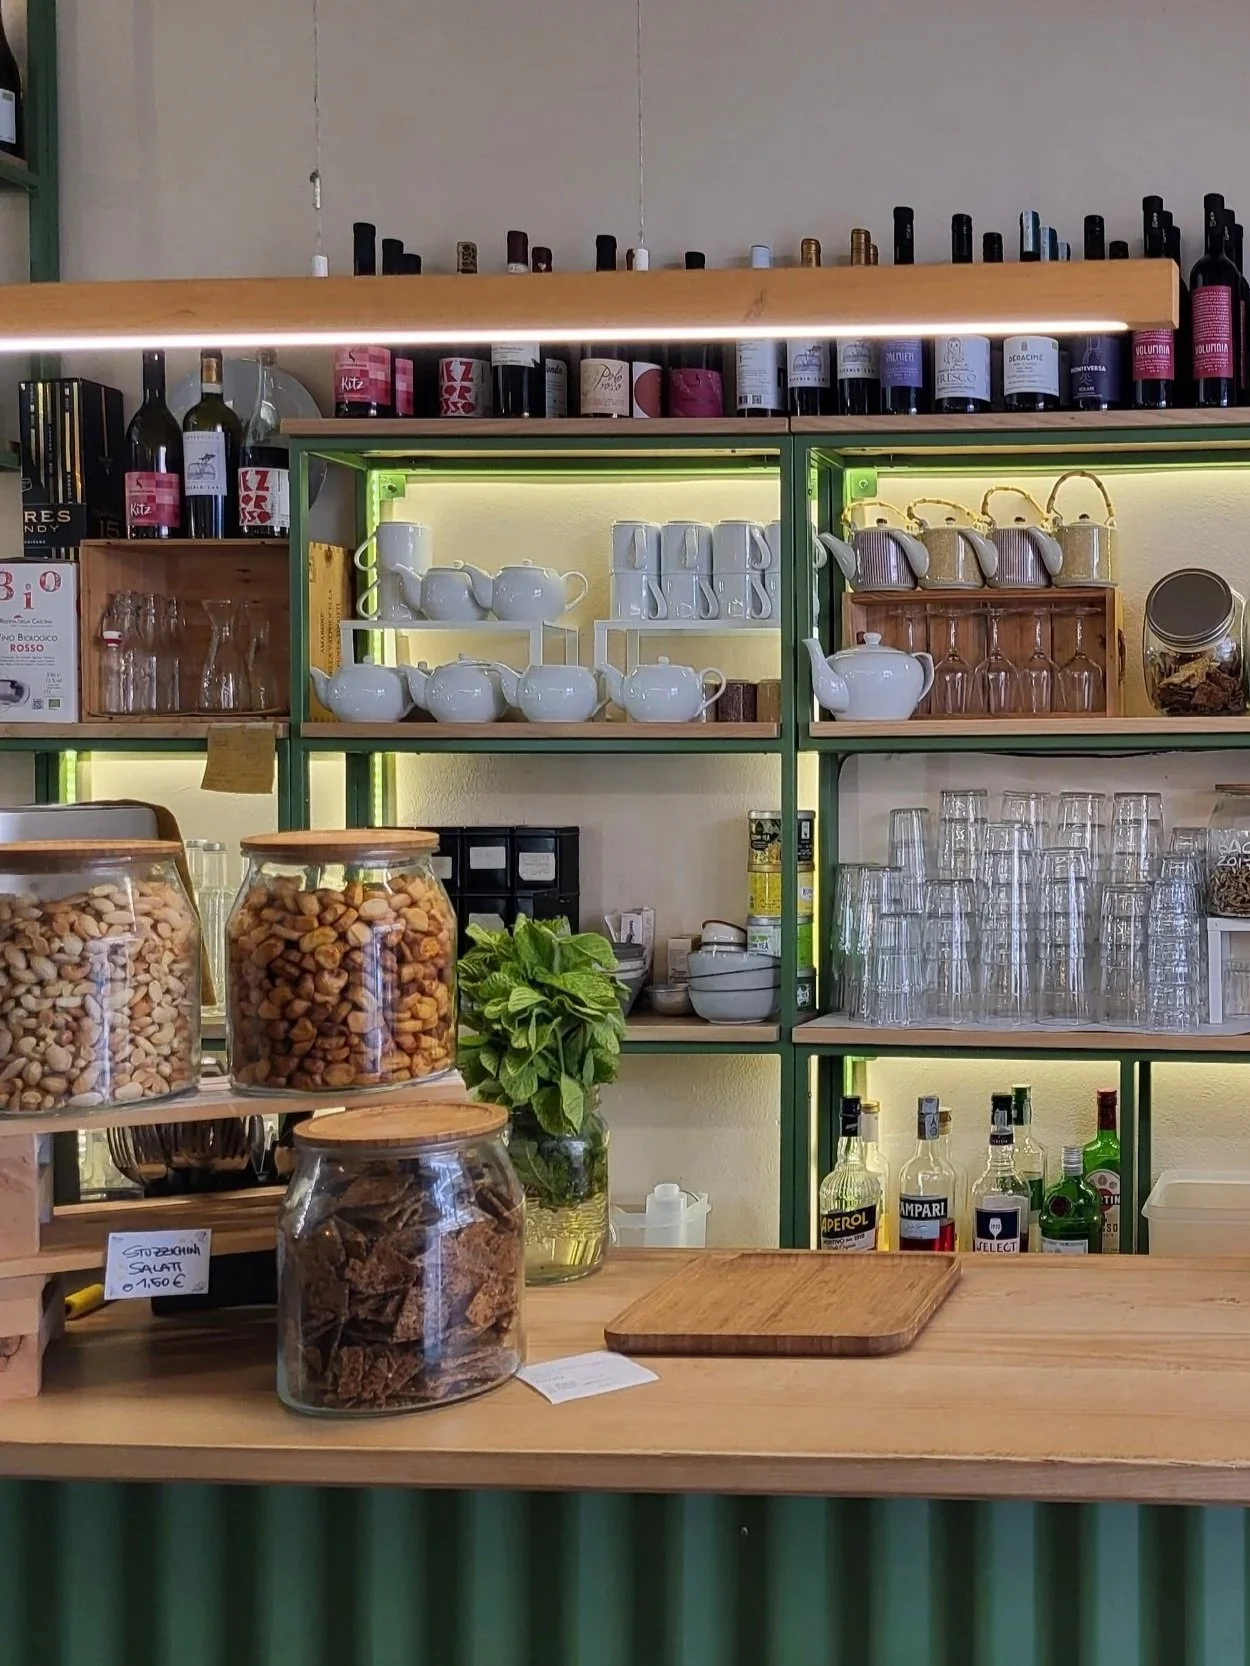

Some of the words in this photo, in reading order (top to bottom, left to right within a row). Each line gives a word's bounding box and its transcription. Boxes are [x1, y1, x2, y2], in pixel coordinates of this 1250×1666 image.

[340, 375, 365, 391] Kitz
[130, 502, 152, 517] Kitz
[10, 644, 45, 653] ROSSO
[821, 1211, 869, 1233] APEROL
[976, 1241, 1018, 1253] SELECT
